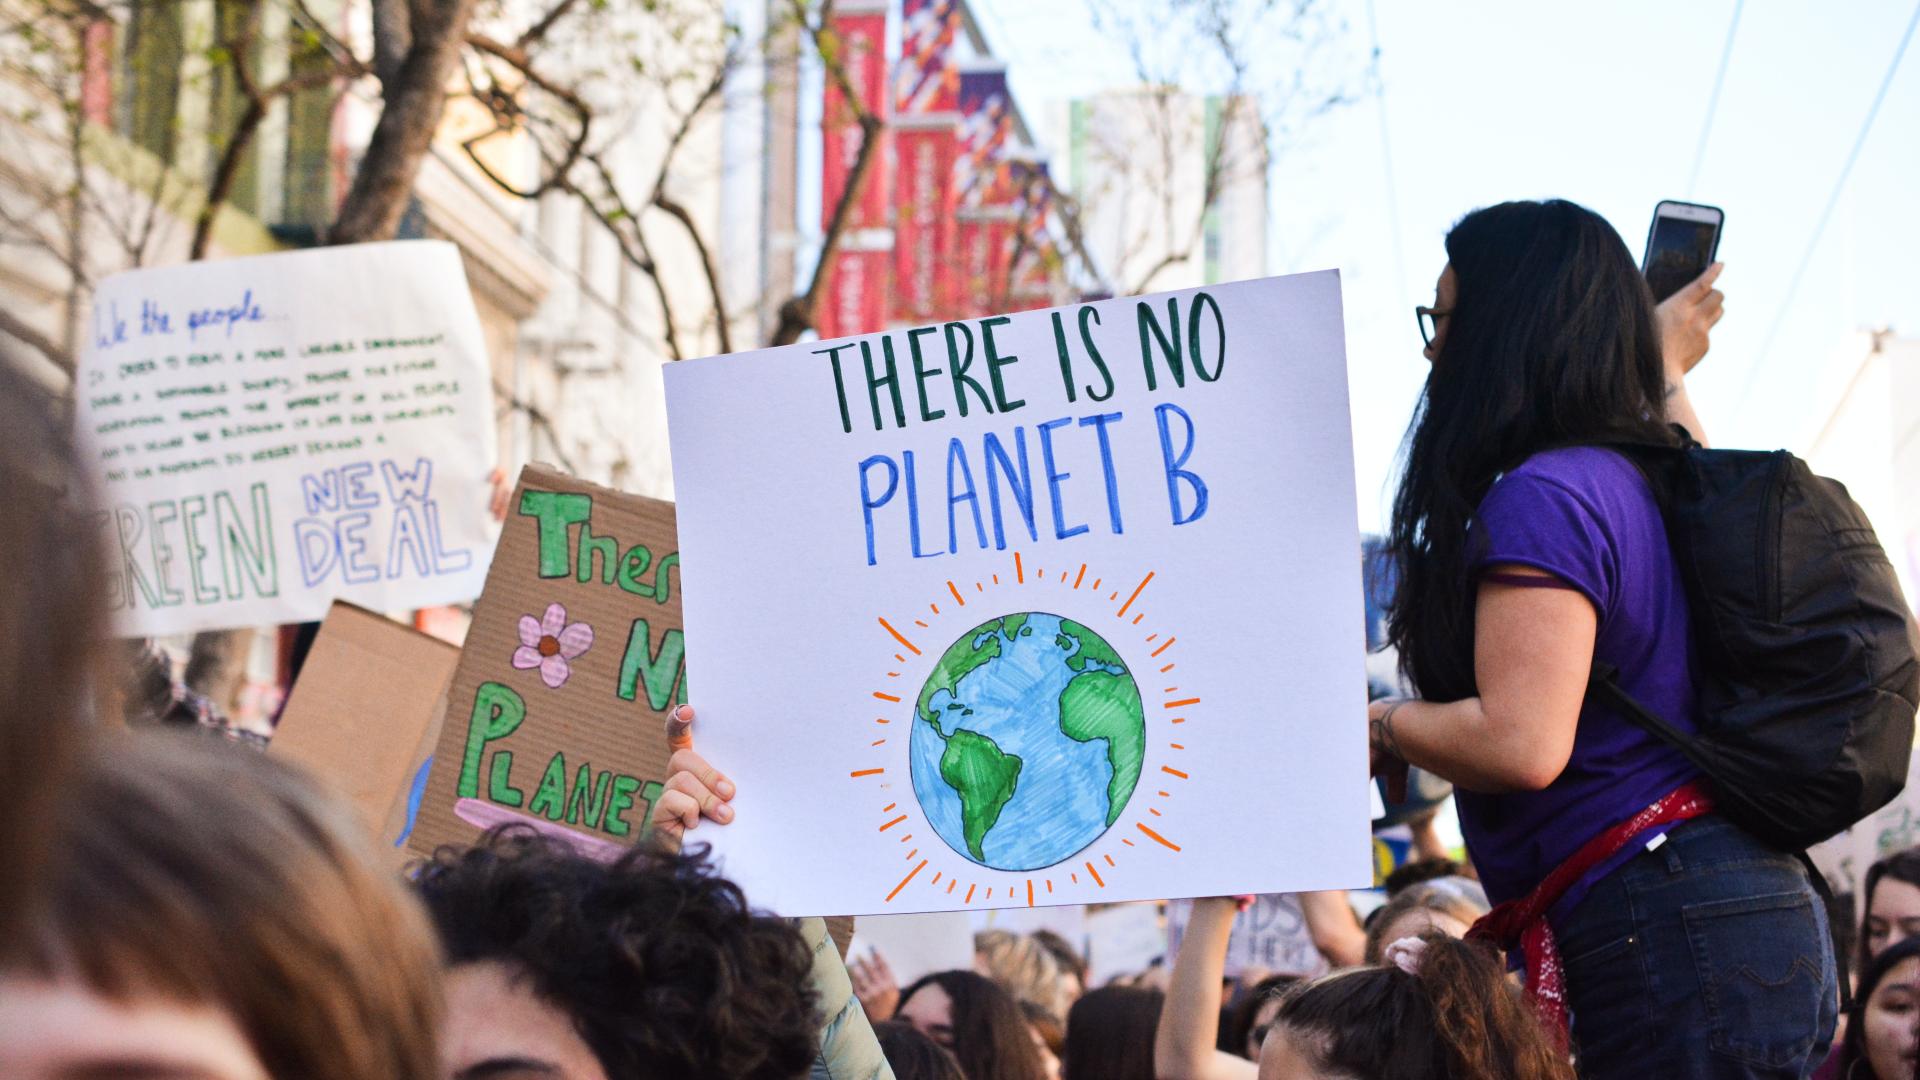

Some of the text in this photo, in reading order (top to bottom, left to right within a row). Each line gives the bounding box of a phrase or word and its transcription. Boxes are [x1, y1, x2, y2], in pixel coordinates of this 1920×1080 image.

[141, 299, 174, 334] the
[811, 291, 1226, 434] THERE IS NO
[301, 457, 432, 516] NEW
[858, 402, 1209, 567] PLANET B
[293, 499, 472, 589] DEAL
[518, 489, 683, 605] Ther
[616, 617, 689, 713] N
